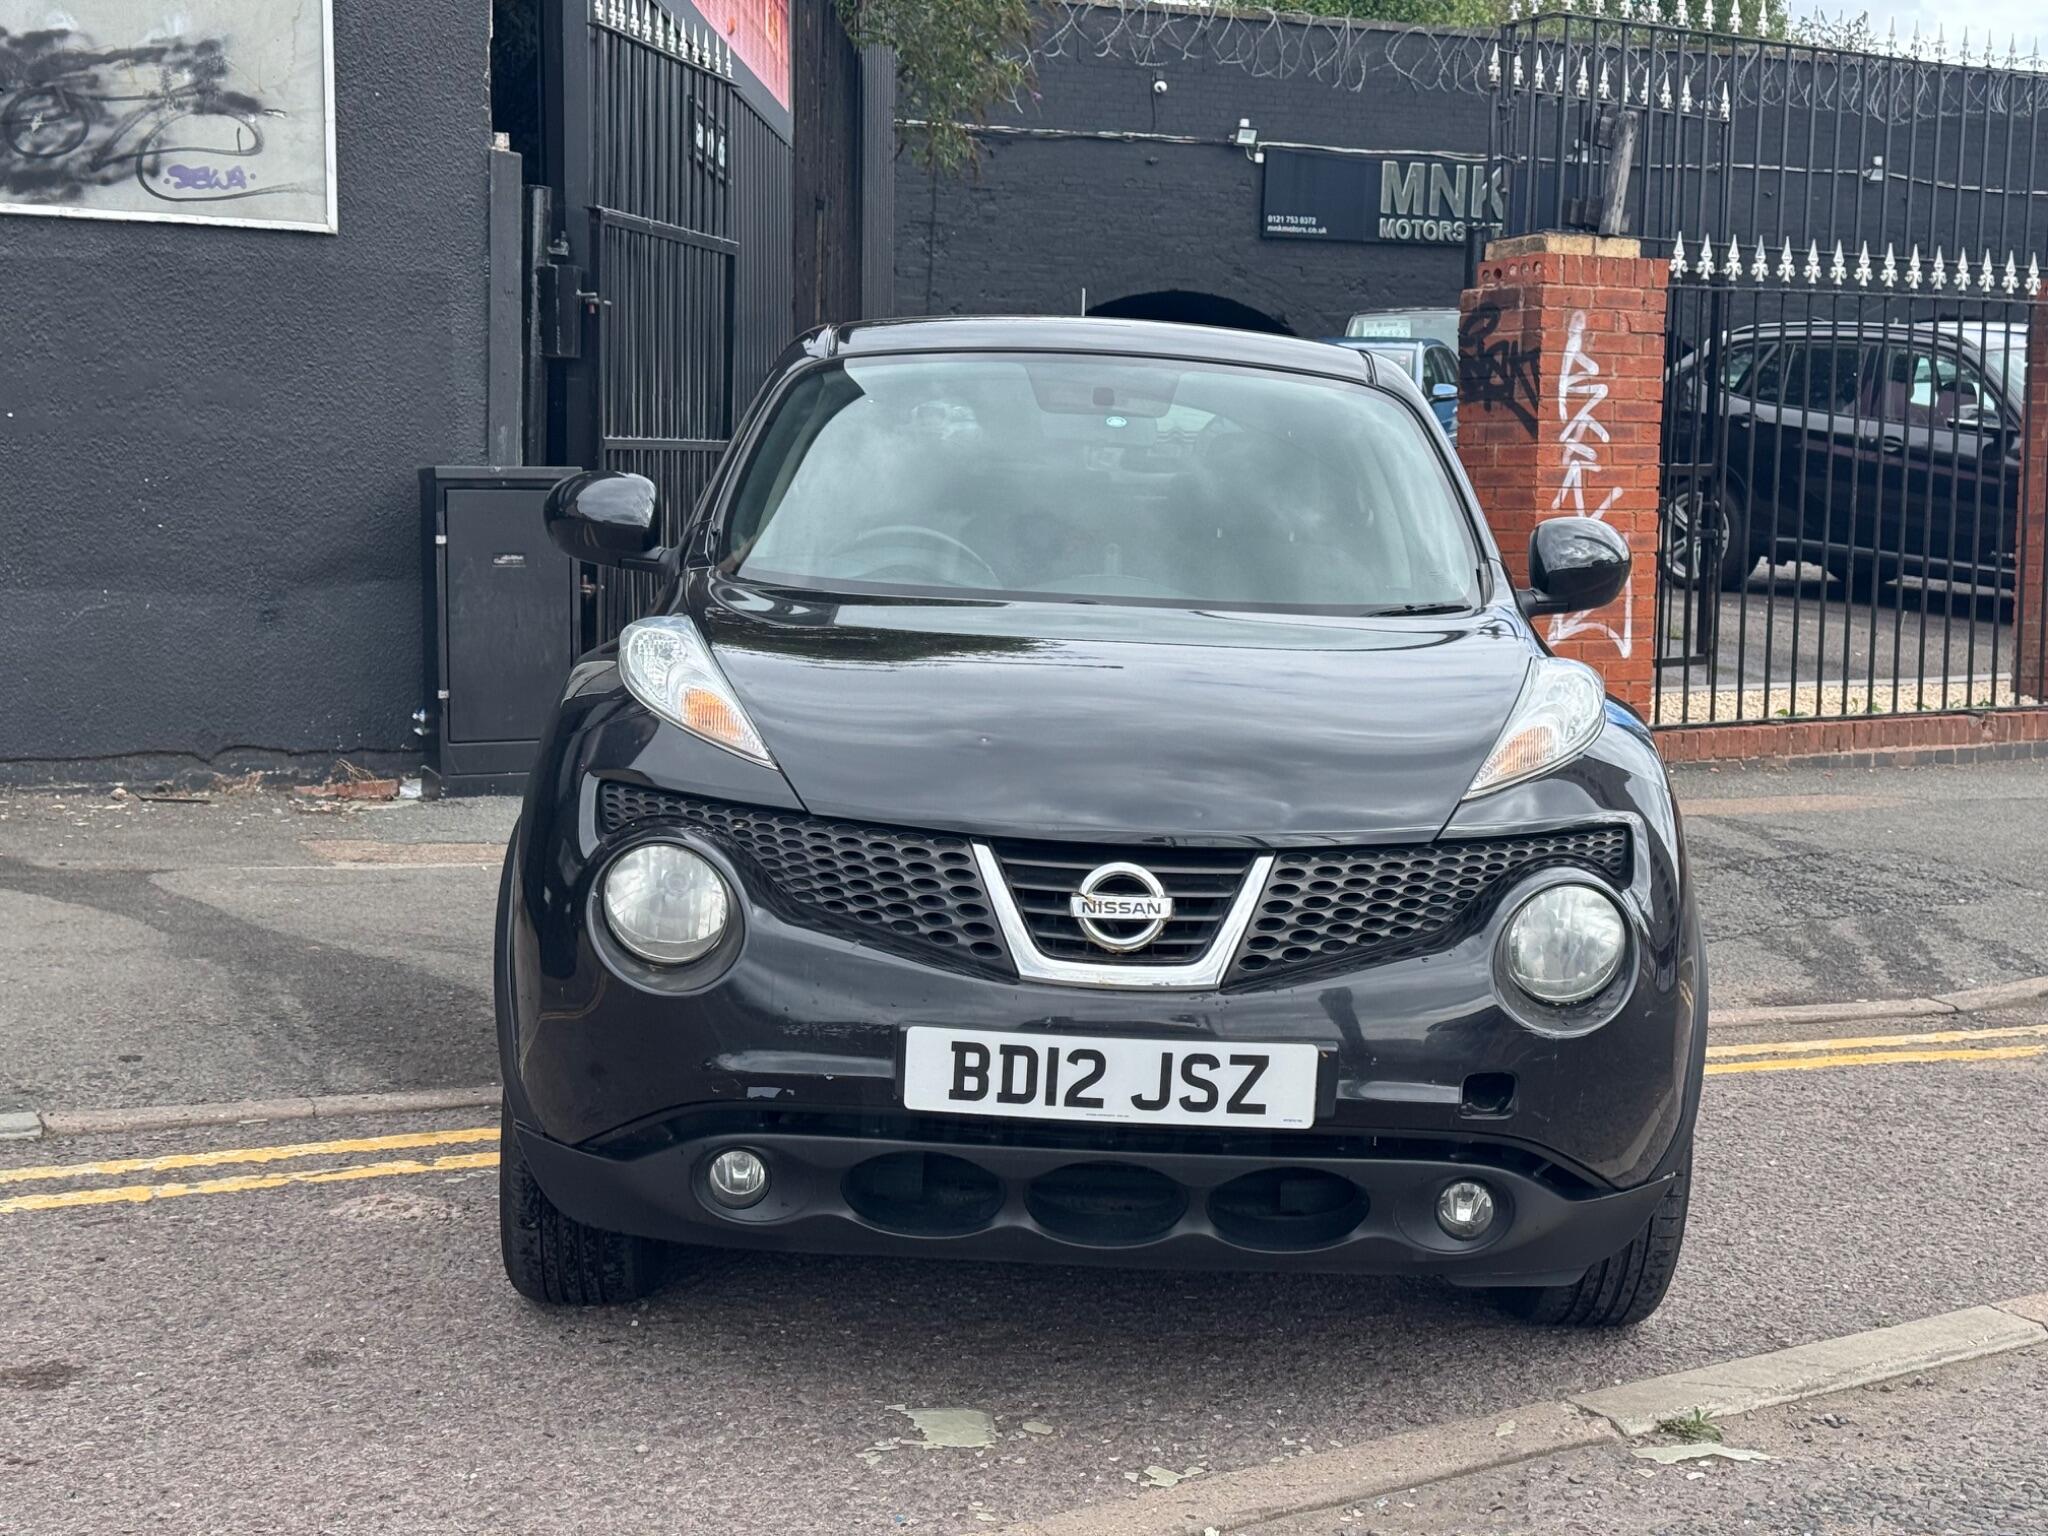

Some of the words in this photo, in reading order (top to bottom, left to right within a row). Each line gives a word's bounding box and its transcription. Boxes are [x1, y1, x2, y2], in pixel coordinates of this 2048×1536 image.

[1380, 160, 1503, 219] MNK
[1379, 217, 1467, 242] MOTORS
[1082, 901, 1161, 915] NISSAN
[948, 1041, 1106, 1108] BD12
[1130, 1051, 1270, 1115] JSZ
